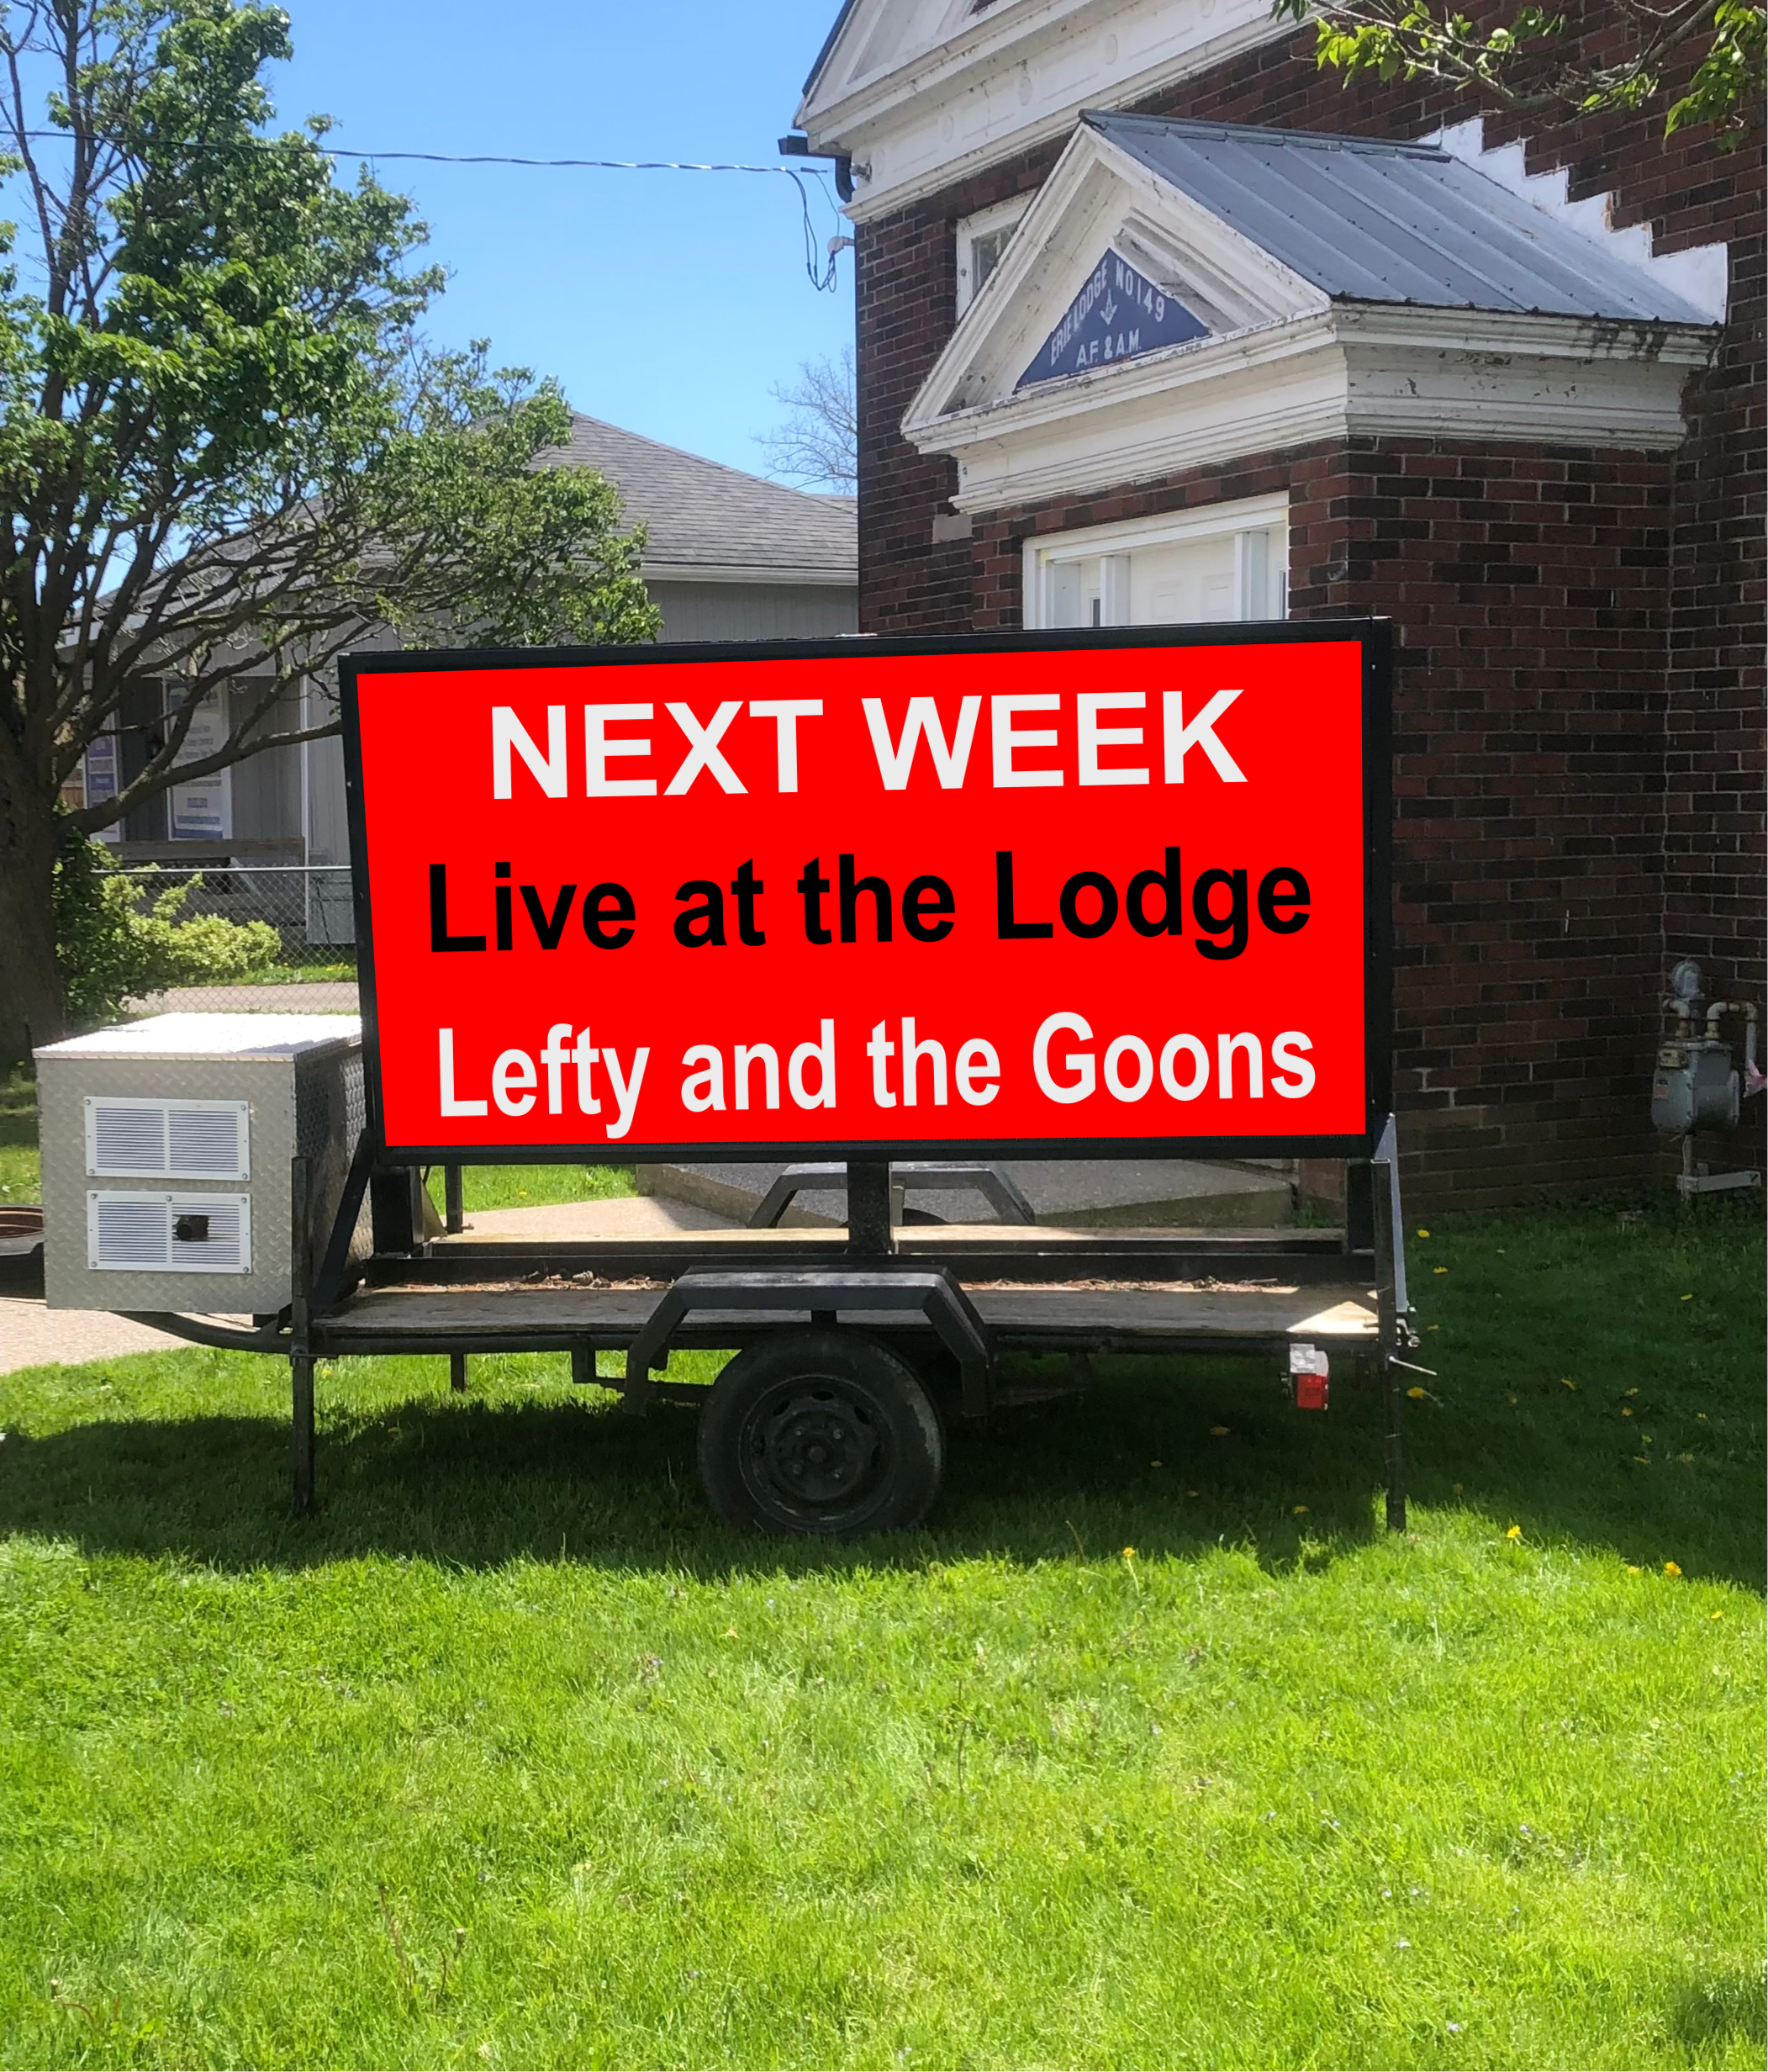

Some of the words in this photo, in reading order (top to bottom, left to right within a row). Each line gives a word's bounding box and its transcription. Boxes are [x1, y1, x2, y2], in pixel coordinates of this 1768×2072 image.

[1050, 314, 1072, 367] ERIE
[1074, 259, 1107, 333] LODGE
[1137, 278, 1165, 323] 149
[1104, 335, 1113, 360] &
[491, 699, 824, 800] NEXT
[861, 689, 1248, 790] WEEK
[429, 861, 636, 953] Live
[673, 858, 766, 949] at
[796, 854, 956, 945] the
[995, 846, 1311, 961] Lodge
[438, 1023, 651, 1139] Lefty
[680, 1018, 837, 1113] and
[866, 1016, 1001, 1108] the
[1032, 1011, 1316, 1104] Goons
